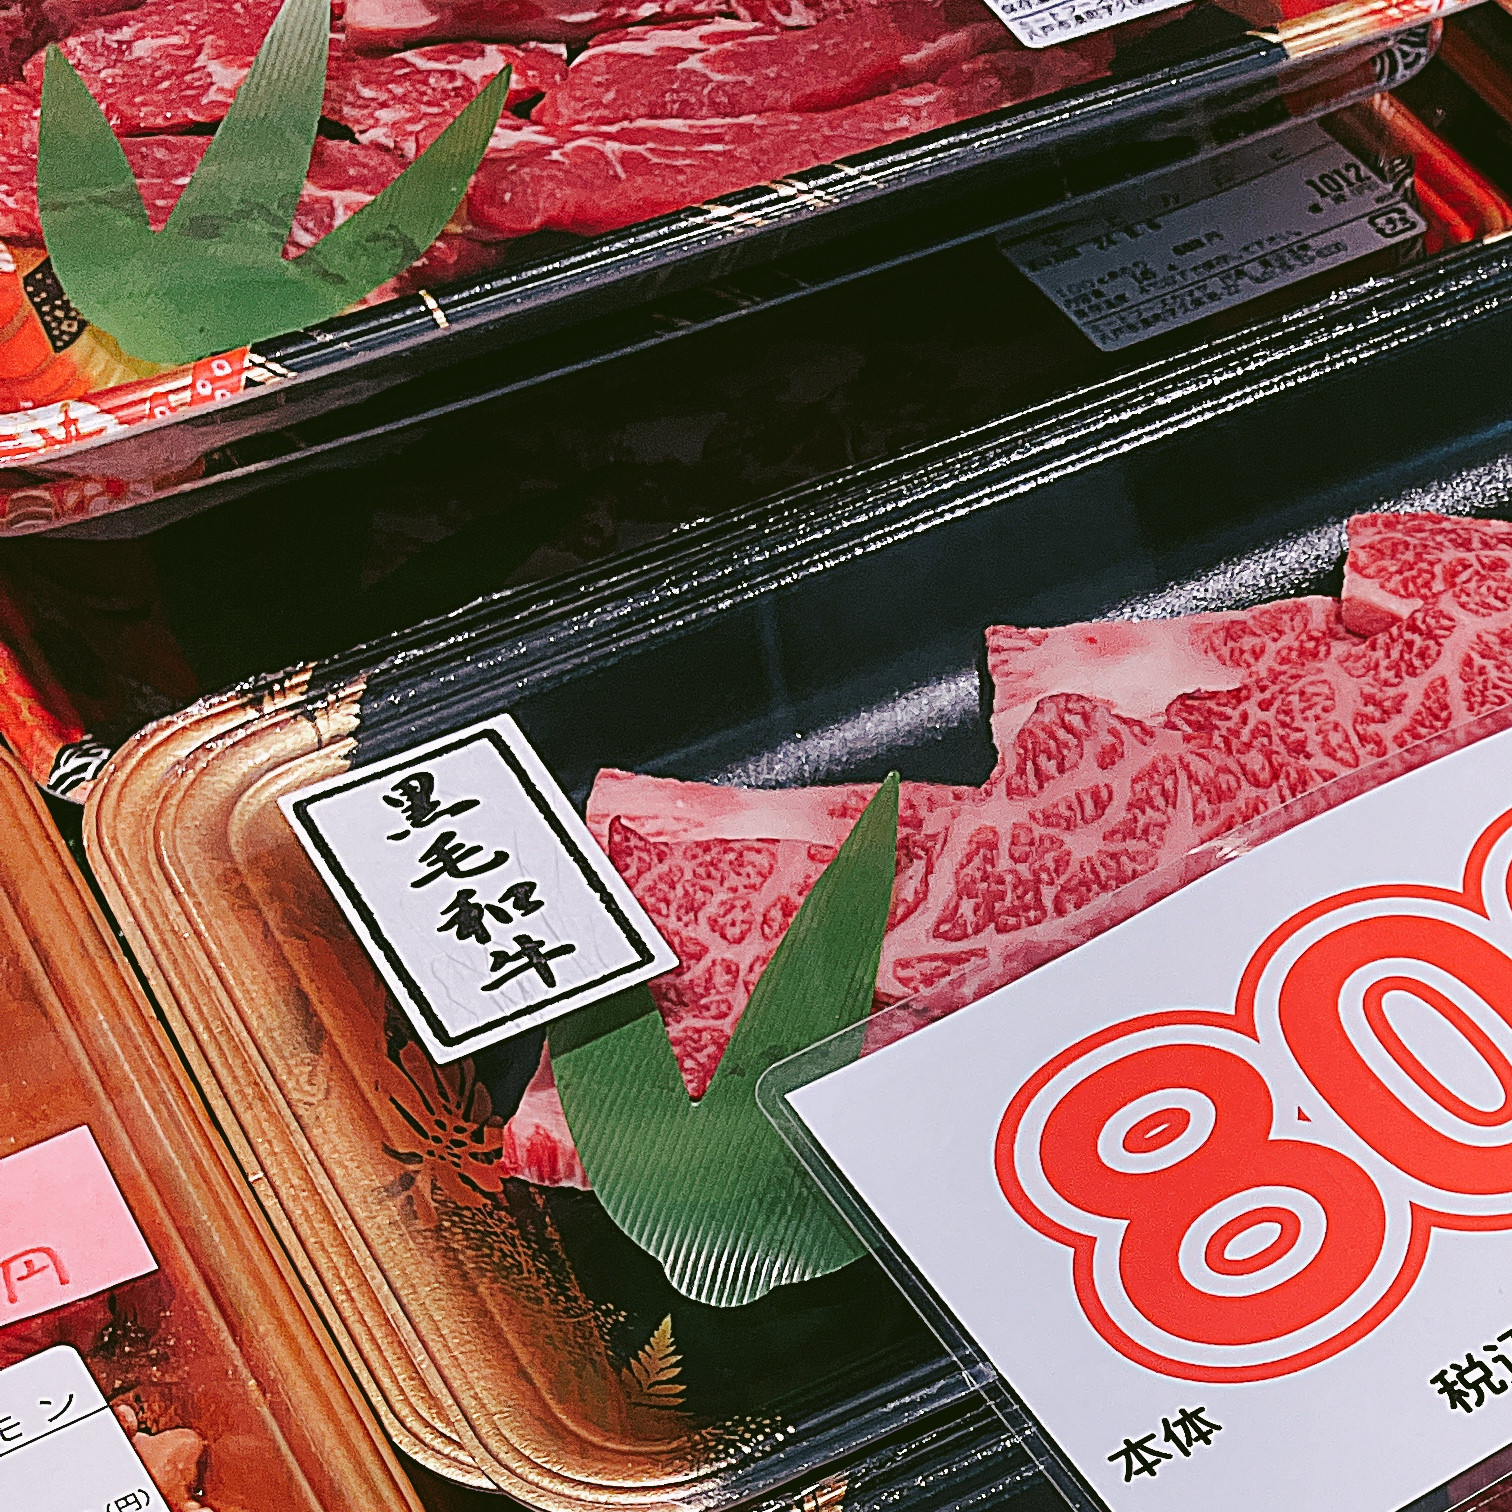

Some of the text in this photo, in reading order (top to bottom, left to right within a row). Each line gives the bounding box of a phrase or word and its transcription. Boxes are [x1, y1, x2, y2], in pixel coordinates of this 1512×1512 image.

[1305, 162, 1371, 200] 1012
[383, 771, 576, 991] 黒毛和牛
[1108, 1407, 1222, 1482] 本体
